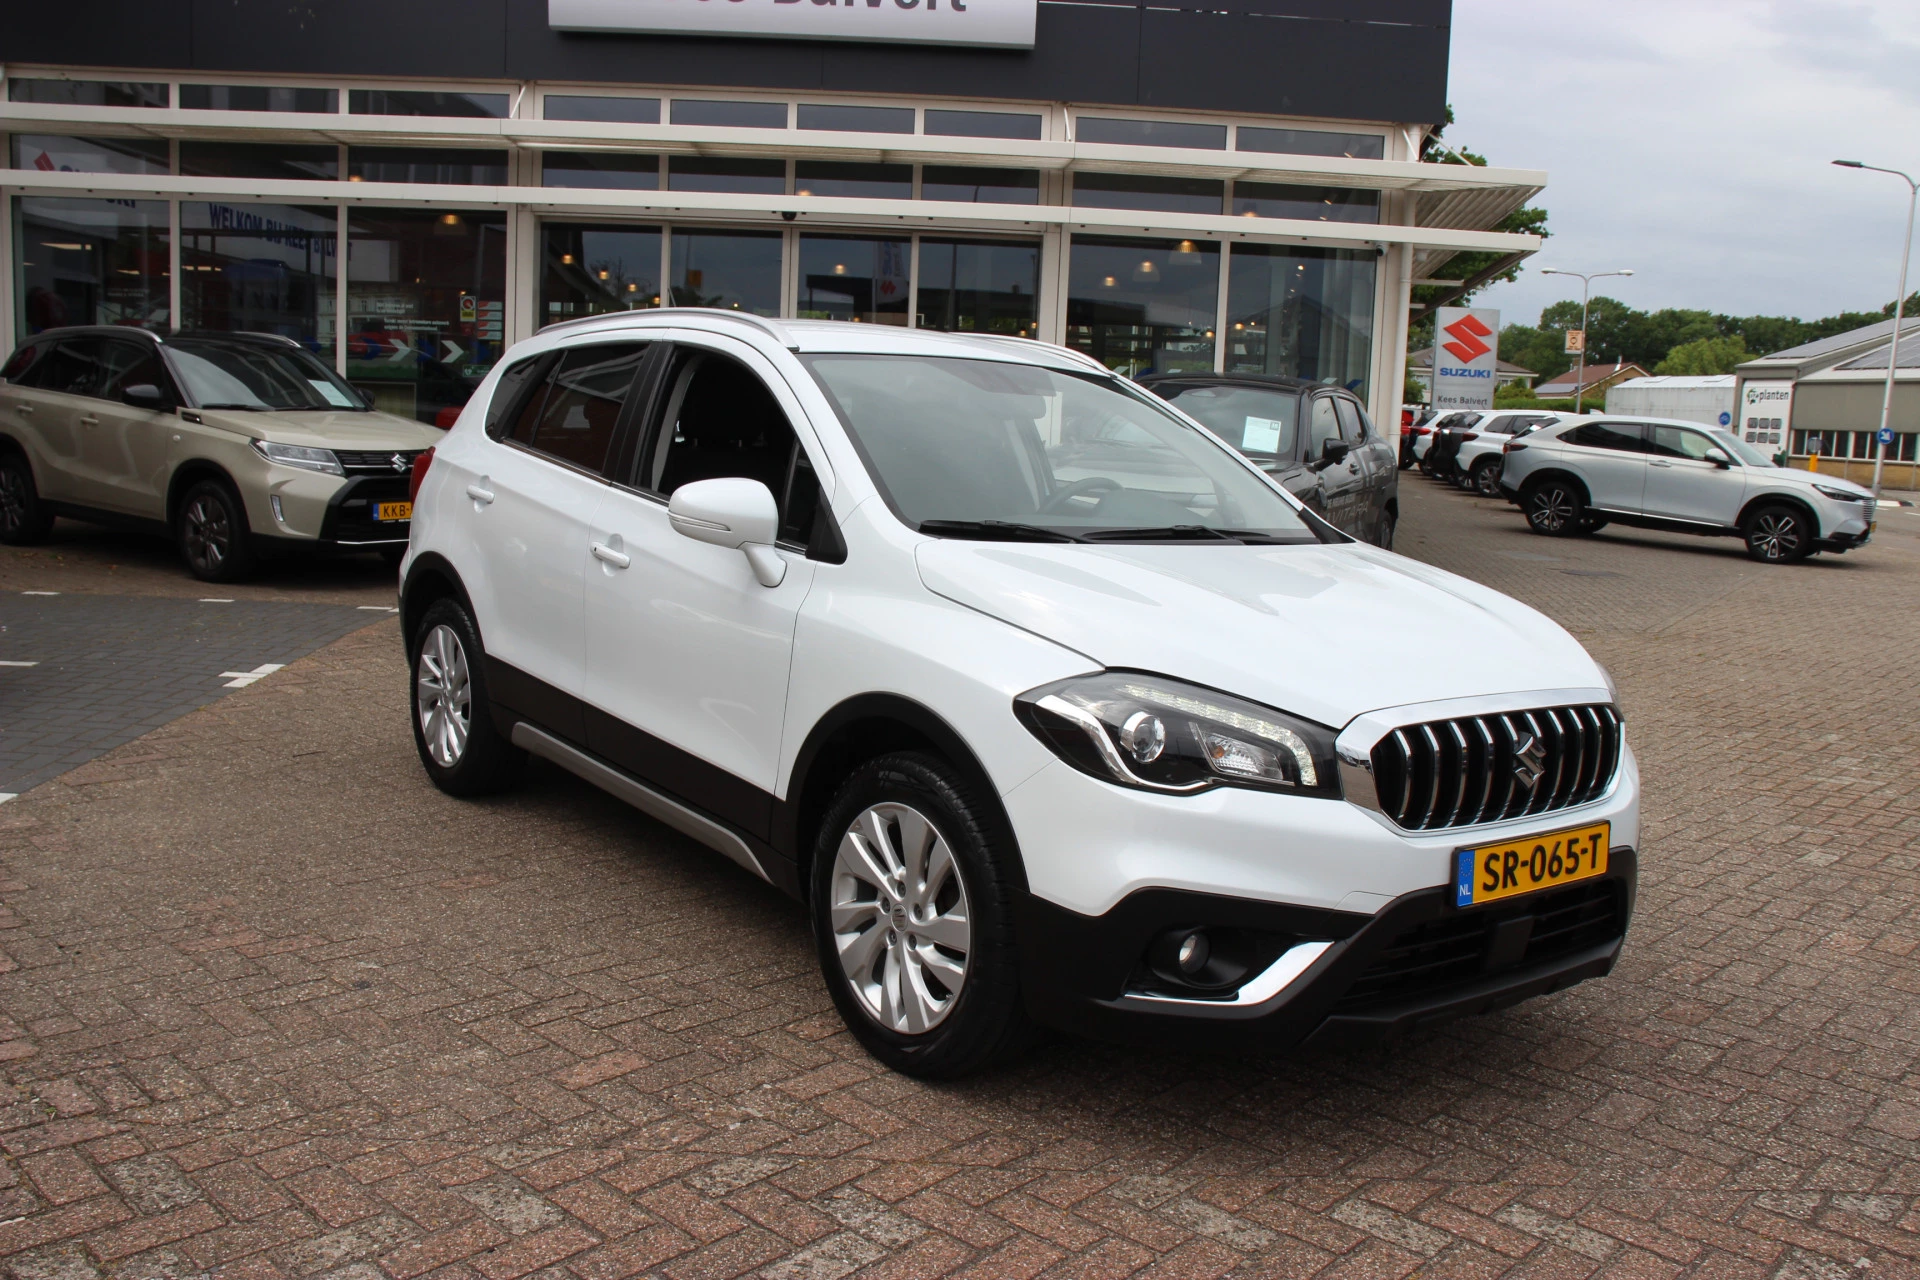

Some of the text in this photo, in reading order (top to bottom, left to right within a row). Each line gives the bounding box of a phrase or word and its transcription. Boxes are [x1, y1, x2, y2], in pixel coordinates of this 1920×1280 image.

[1440, 367, 1491, 379] SUZUKI
[1437, 395, 1488, 406] Kees Balvert
[1482, 832, 1603, 892] SR-065-T
[1459, 883, 1471, 897] NL
